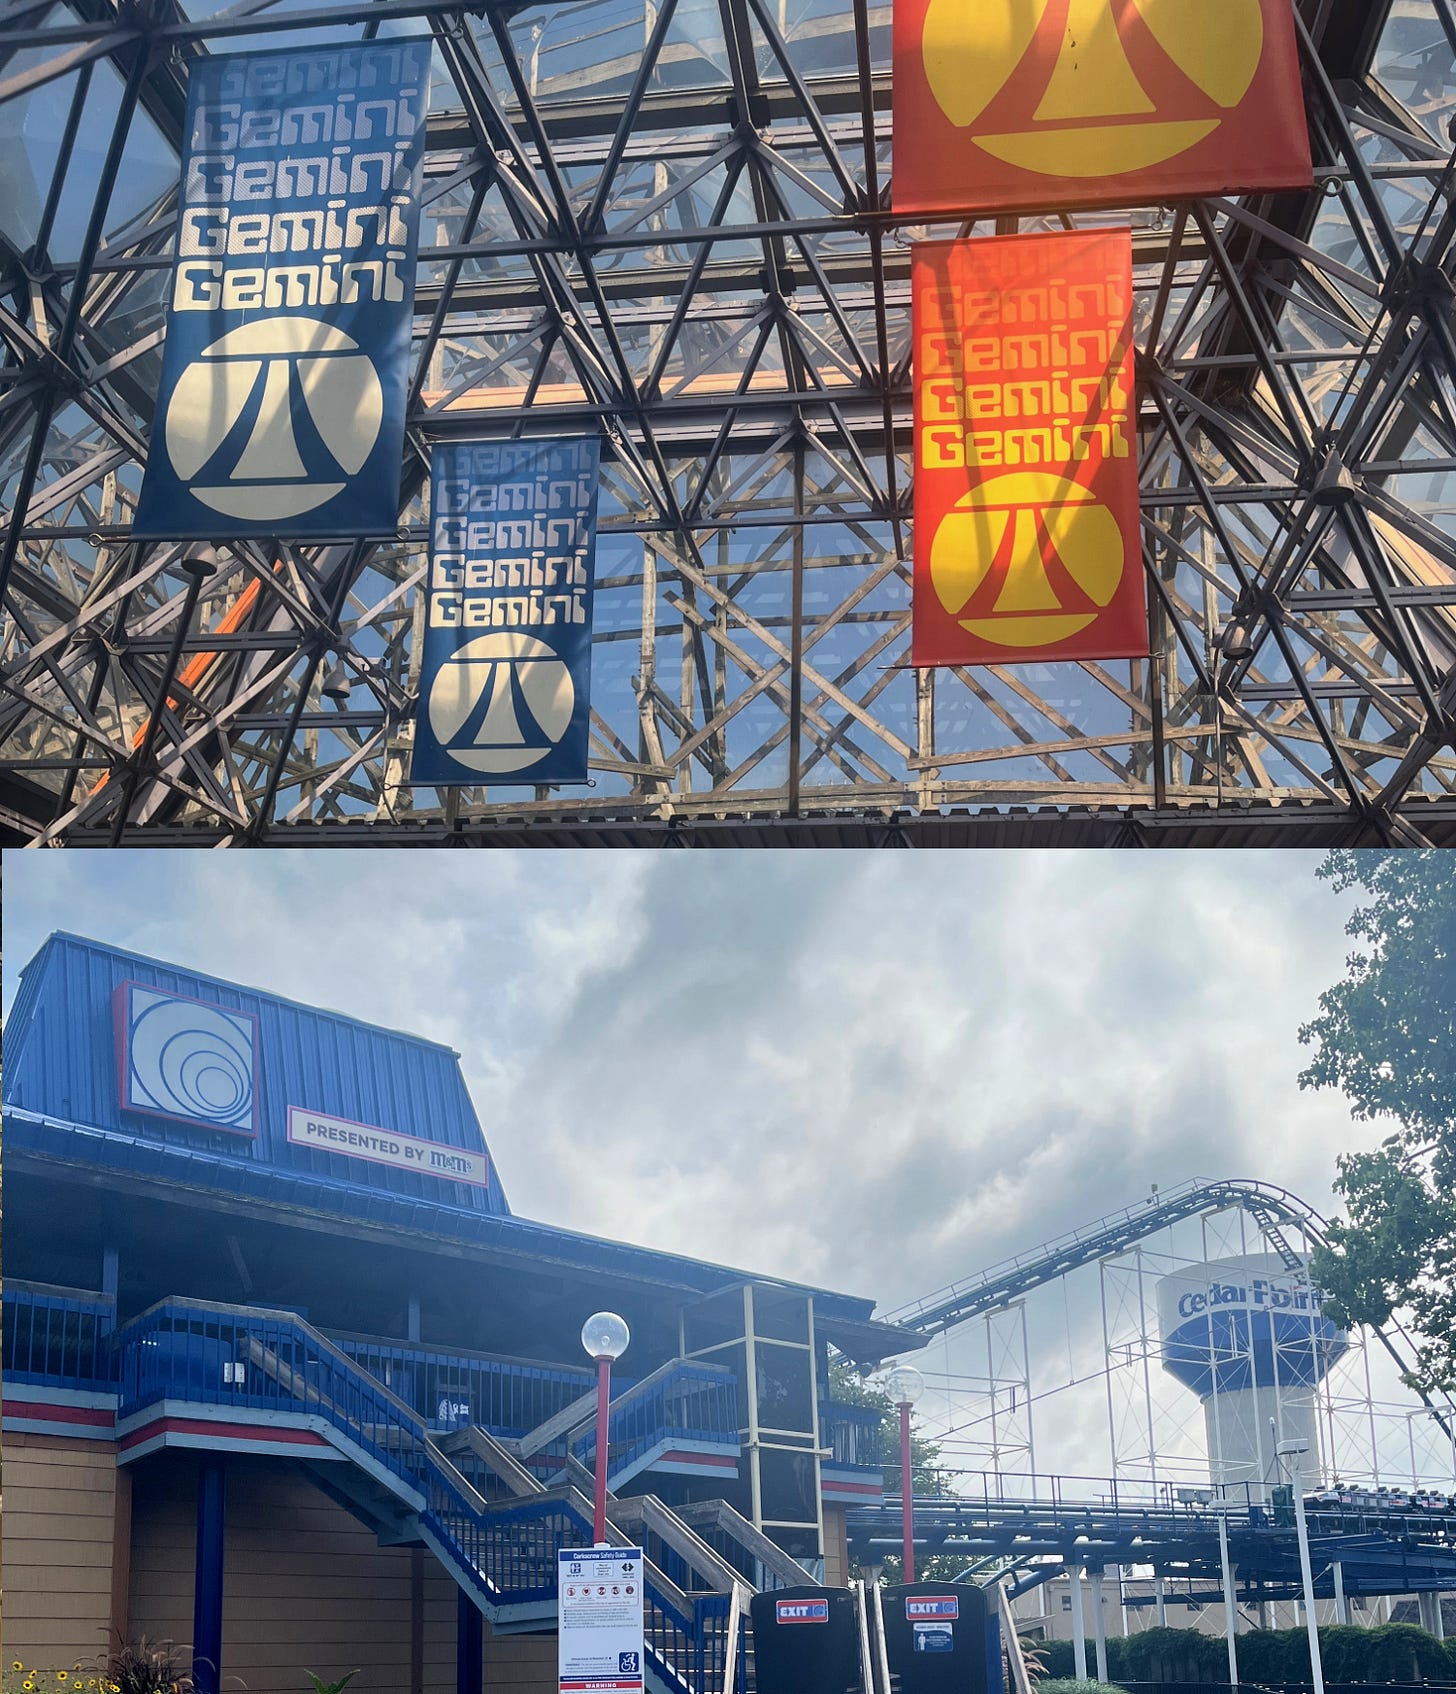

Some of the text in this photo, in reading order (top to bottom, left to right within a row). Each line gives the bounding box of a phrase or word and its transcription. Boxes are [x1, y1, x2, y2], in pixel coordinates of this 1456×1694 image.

[191, 88, 418, 151] Gemini
[185, 141, 413, 203] Gemini
[179, 195, 410, 257] Gemini
[173, 250, 407, 312] Gemini
[921, 274, 1124, 329] Gemini
[921, 320, 1125, 375] Gemini
[921, 367, 1127, 421] Gemini
[922, 414, 1129, 469] Gemini
[436, 473, 591, 513] Gemini
[435, 511, 589, 550] Gemini
[432, 549, 588, 589] Gemini
[429, 588, 586, 628] Gemini
[306, 1121, 400, 1155] PRESENTED
[404, 1146, 425, 1161] BY
[780, 1606, 808, 1617] EXIT
[910, 1603, 938, 1614] EXIT
